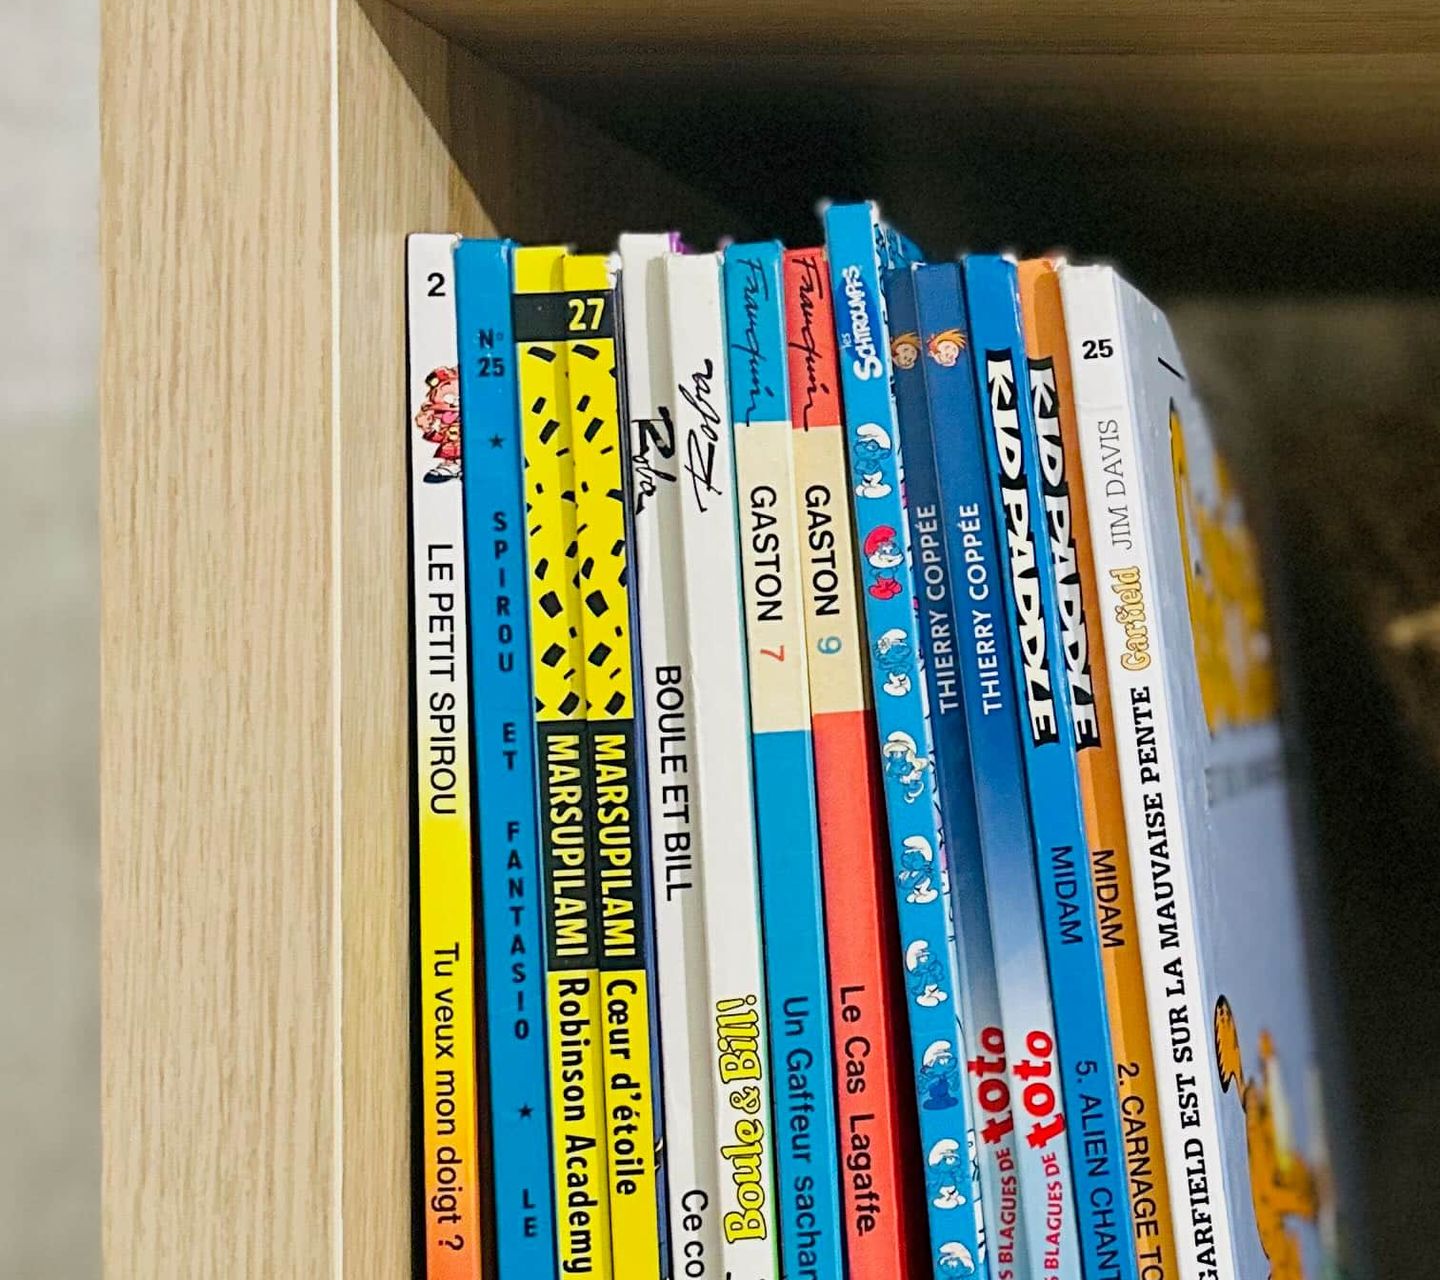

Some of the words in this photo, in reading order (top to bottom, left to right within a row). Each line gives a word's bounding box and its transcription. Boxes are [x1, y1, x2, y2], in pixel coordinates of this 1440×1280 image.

[427, 272, 446, 297] 2
[568, 298, 605, 331] 27
[478, 357, 505, 377] 25
[1082, 338, 1114, 360] 25
[986, 360, 1023, 480] KID
[1029, 368, 1064, 487] KID
[1098, 419, 1127, 497] DAVIS
[428, 544, 454, 581] LE
[749, 485, 783, 621] GASTON
[804, 484, 840, 616] GASTON
[917, 503, 946, 601] COPPÉE
[960, 502, 989, 601] COPPÉE
[1108, 505, 1133, 551] JIM
[492, 512, 514, 672] SPIROU
[1002, 487, 1057, 741] PADDLE
[1045, 495, 1098, 744] PADDLE
[1109, 565, 1152, 672] Garfield
[428, 593, 455, 682] PETIT
[760, 645, 785, 662] 7
[817, 635, 842, 654] 9
[929, 609, 960, 715] THIERRY
[973, 608, 1003, 715] THIERRY
[429, 692, 457, 815] SPIROU
[503, 722, 518, 762] ET
[656, 665, 688, 774] BOULE
[1129, 685, 1160, 784] PENTE
[546, 735, 590, 957] MARSUPILAMI
[594, 734, 636, 957] MARSUPILAMI
[662, 784, 689, 824] ET
[664, 831, 693, 902] BILL
[1051, 845, 1084, 945] MIDAM
[1092, 849, 1125, 948] MIDAM
[1144, 792, 1181, 950] MAUVAISE
[434, 942, 460, 977] Tu
[506, 821, 530, 1040] FANTASIO
[783, 995, 810, 1037] Un
[839, 985, 866, 1023] Le
[1163, 957, 1187, 998] LA
[434, 988, 455, 1059] veux
[557, 977, 591, 1122] Robinson
[844, 1036, 871, 1094] Cas
[1169, 1005, 1193, 1065] SUR
[435, 1070, 456, 1136] mon
[729, 1085, 761, 1114] &
[785, 1048, 815, 1163] Gaffeur
[967, 1026, 1015, 1145] toto
[1013, 1030, 1067, 1149] toto
[1075, 1060, 1098, 1084] 5.
[1117, 1062, 1140, 1085] 2.
[1176, 1073, 1200, 1130] EST
[847, 1113, 881, 1237] Lagaffe
[996, 1147, 1013, 1170] DE
[1042, 1152, 1060, 1177] DE
[1079, 1094, 1109, 1177] ALIEN
[1121, 1095, 1160, 1238] CARNAGE
[431, 1146, 463, 1224] doigt
[522, 1188, 538, 1238] LE
[563, 1134, 598, 1273] Academy
[681, 1189, 709, 1232] Ce
[720, 1118, 768, 1243] Boule
[999, 1173, 1017, 1262] BLAGUES
[1044, 1180, 1063, 1269] BLAGUES
[438, 1234, 465, 1251] ?
